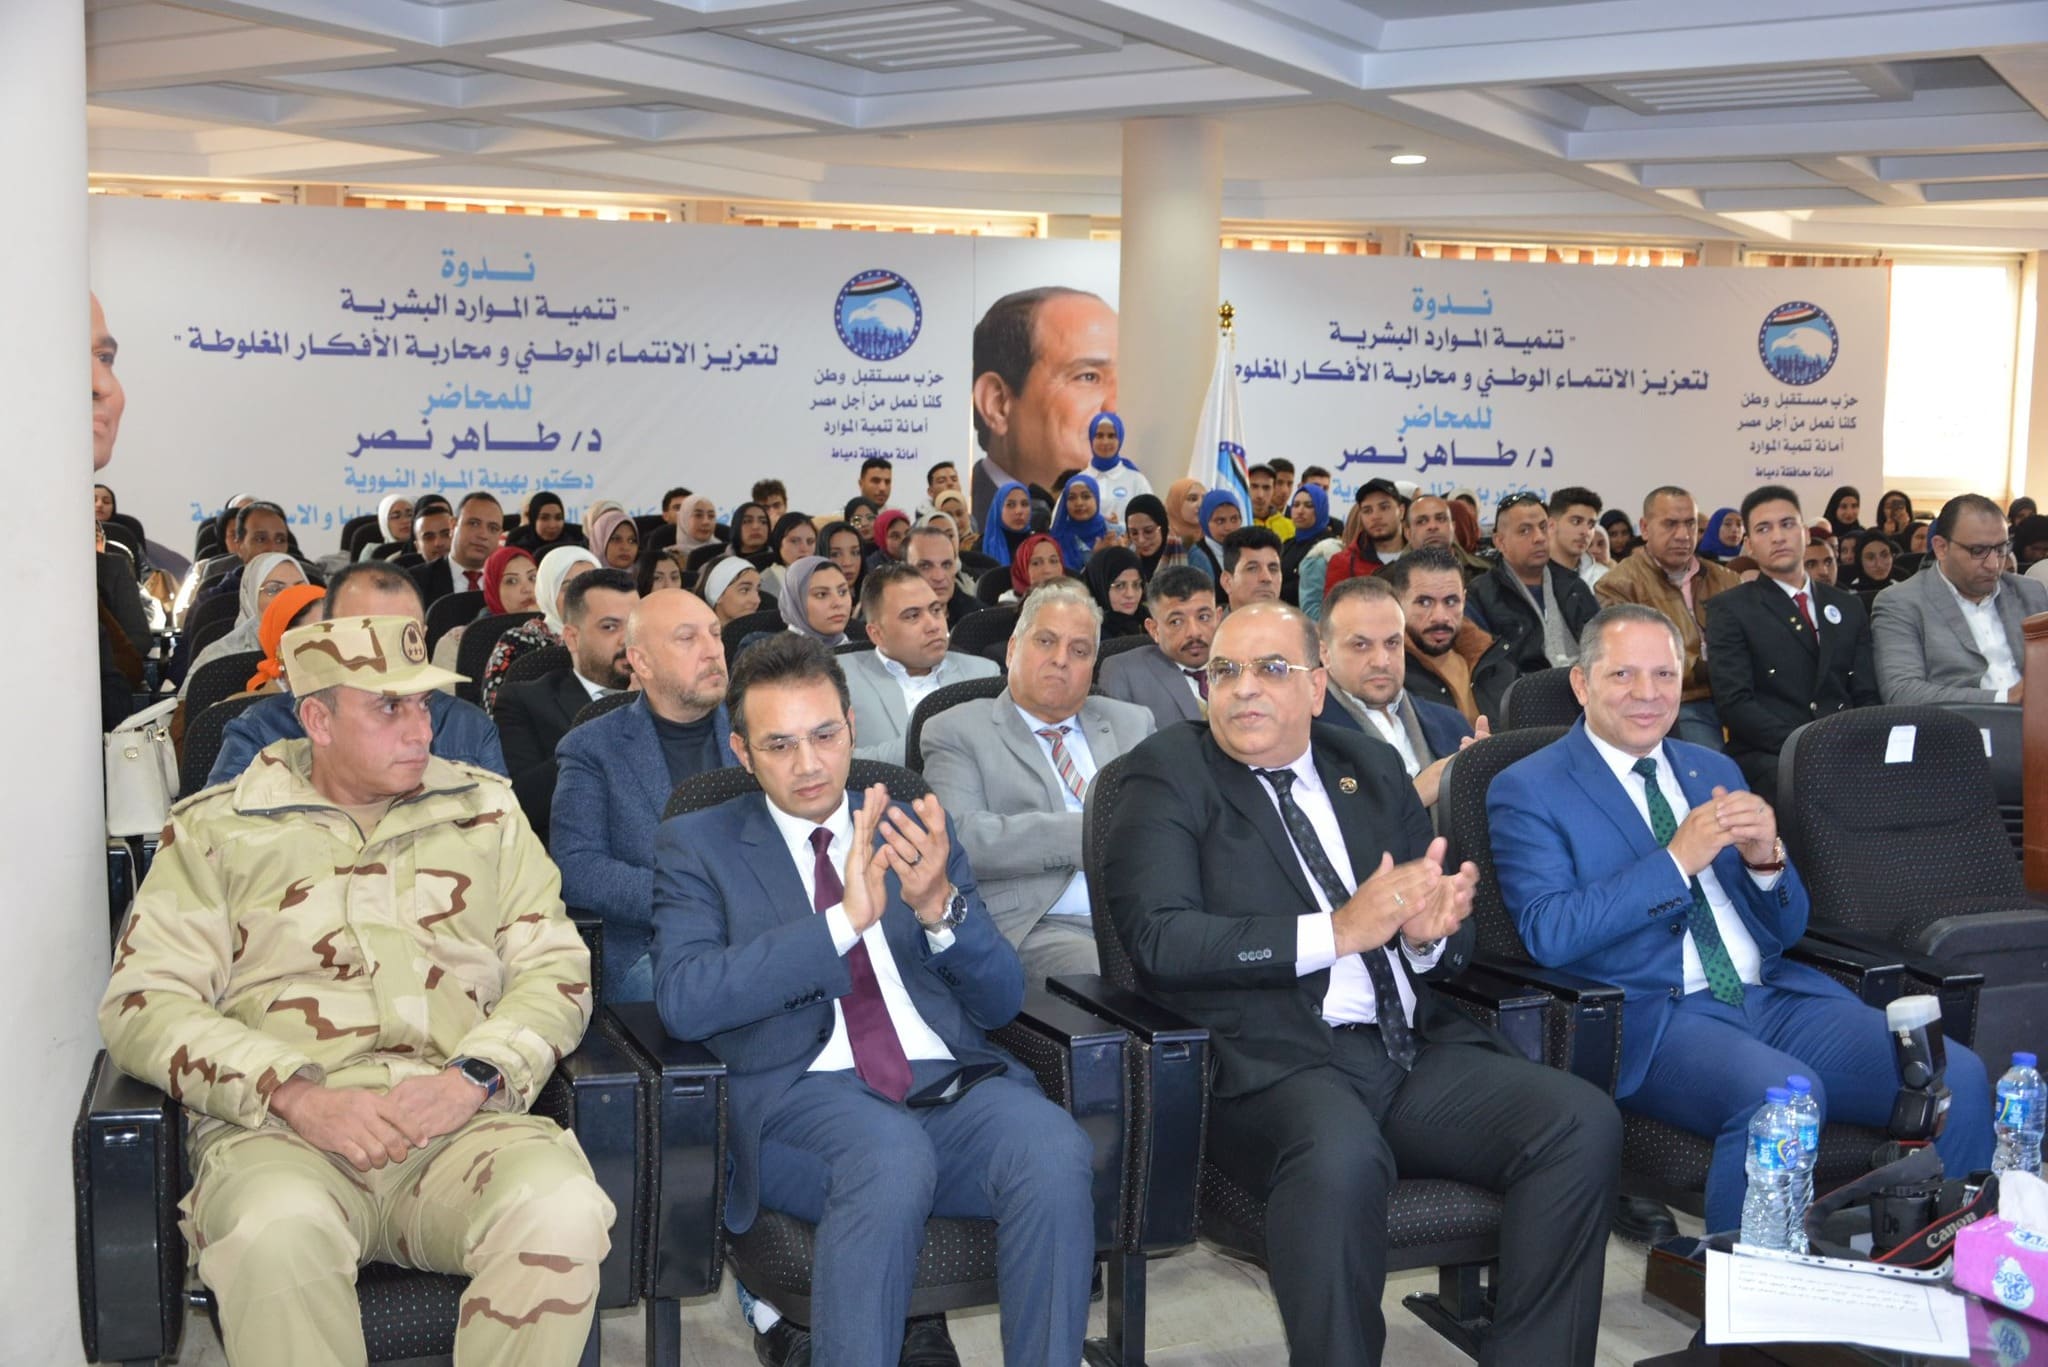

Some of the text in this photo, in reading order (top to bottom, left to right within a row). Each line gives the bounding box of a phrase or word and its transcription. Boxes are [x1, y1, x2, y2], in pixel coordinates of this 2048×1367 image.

[440, 248, 536, 288] ندوة
[339, 288, 448, 322] البشرية
[454, 293, 529, 323] الموارد
[535, 294, 618, 327] تنمية
[1411, 286, 1493, 321] ندوة
[187, 326, 290, 359] المغلوطة
[293, 327, 398, 360] الأفكار
[405, 333, 493, 366] محاربة
[1329, 321, 1418, 351] البشرية
[1424, 325, 1488, 352] الموارد
[1492, 326, 1565, 355] تنمية
[496, 345, 509, 367] و
[514, 339, 601, 375] الوطني
[605, 339, 696, 367] الانتماء
[699, 341, 780, 372] لتعزيز
[814, 368, 944, 387] حزب مستقبل وطن
[1290, 355, 1379, 385] الأفكار
[1382, 360, 1457, 390] محاربة
[1460, 371, 1473, 391] و
[1476, 365, 1551, 398] الوطني
[1555, 367, 1635, 391] الانتماء
[1639, 367, 1710, 396] لتعزيز
[418, 380, 533, 416] للمحاضر
[1740, 391, 1859, 410] حزب مستقبل وطن
[1396, 402, 1493, 434] للمحاضر
[346, 416, 434, 459] نصر
[441, 420, 562, 460] طاهر
[1335, 436, 1408, 471] نصر
[1415, 438, 1519, 473] طاهر
[343, 465, 416, 494] النووية
[420, 468, 473, 493] المواد
[1925, 1211, 1978, 1249] Canon
